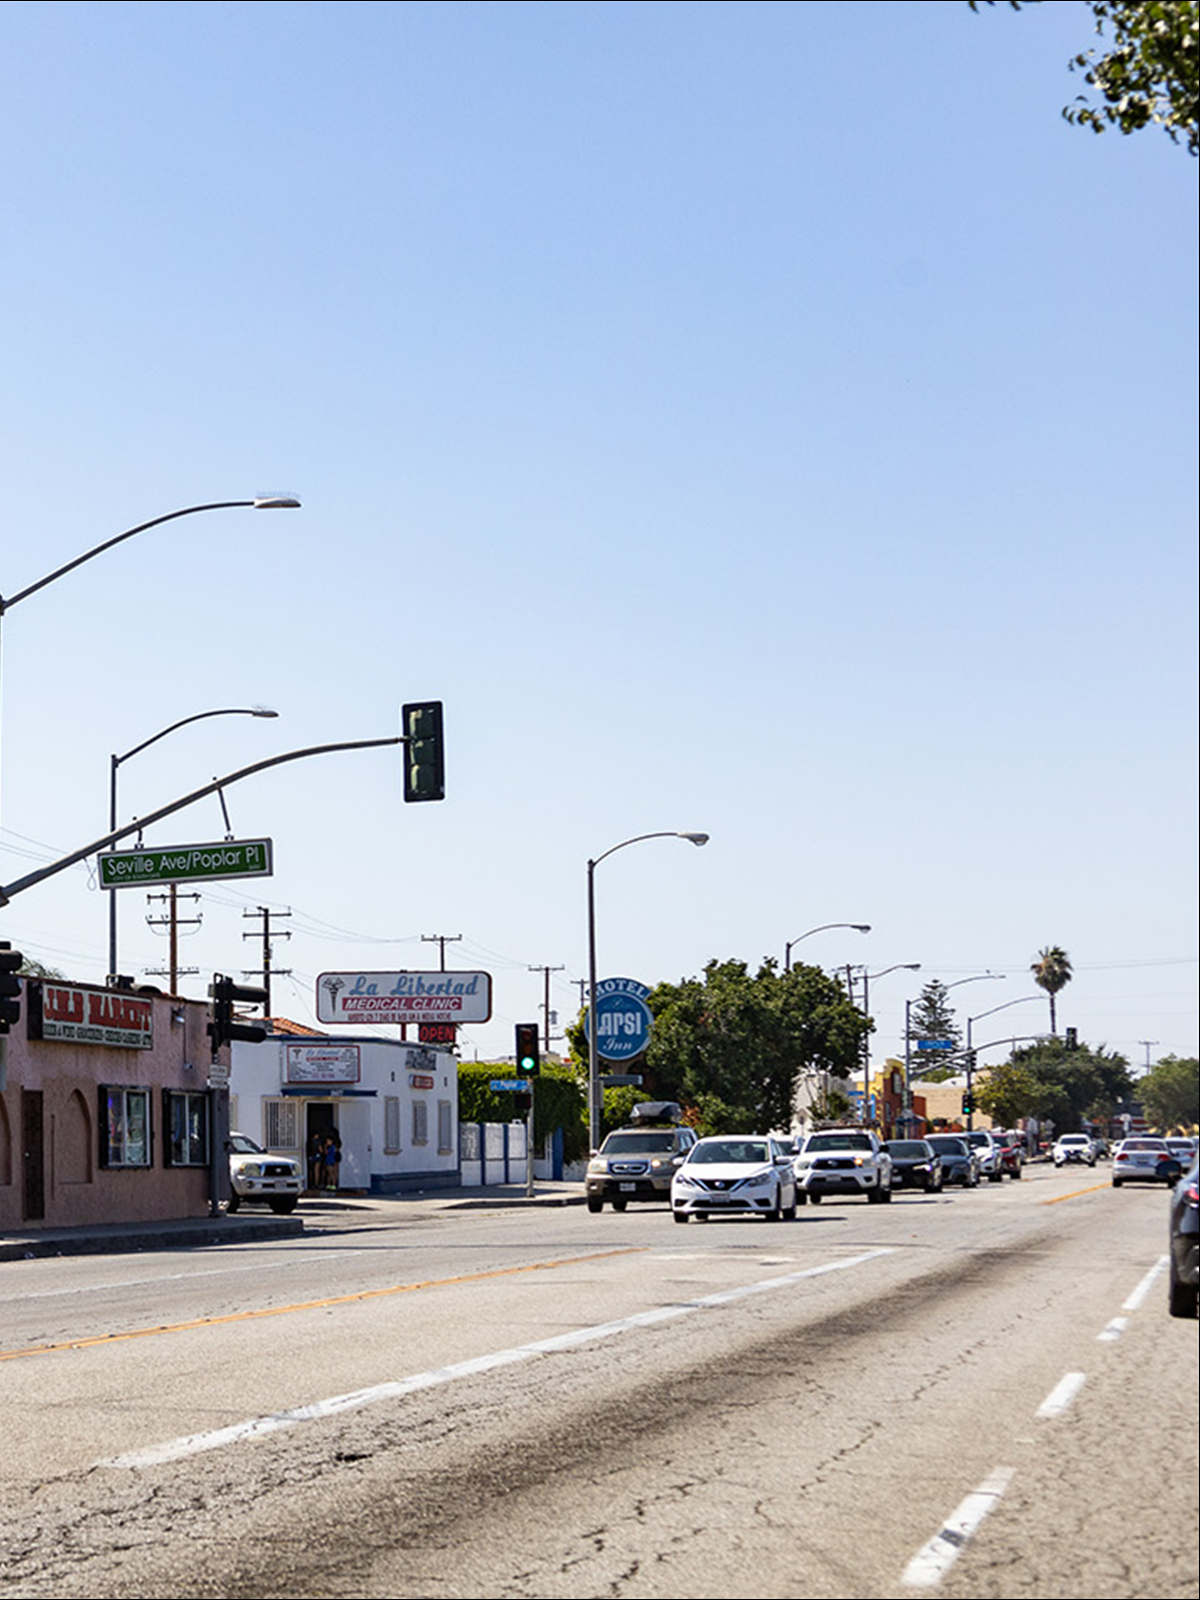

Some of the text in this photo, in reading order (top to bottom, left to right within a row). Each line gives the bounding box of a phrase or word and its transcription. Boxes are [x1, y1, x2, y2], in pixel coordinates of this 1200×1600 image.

[107, 846, 260, 876] Seville Ave/Poplar Pl
[348, 975, 479, 996] La Libertad
[88, 993, 152, 1032] MARKET
[345, 999, 460, 1010] MEDICAL CLINIC
[420, 1026, 455, 1041] OPEN
[603, 1037, 632, 1050] Inn
